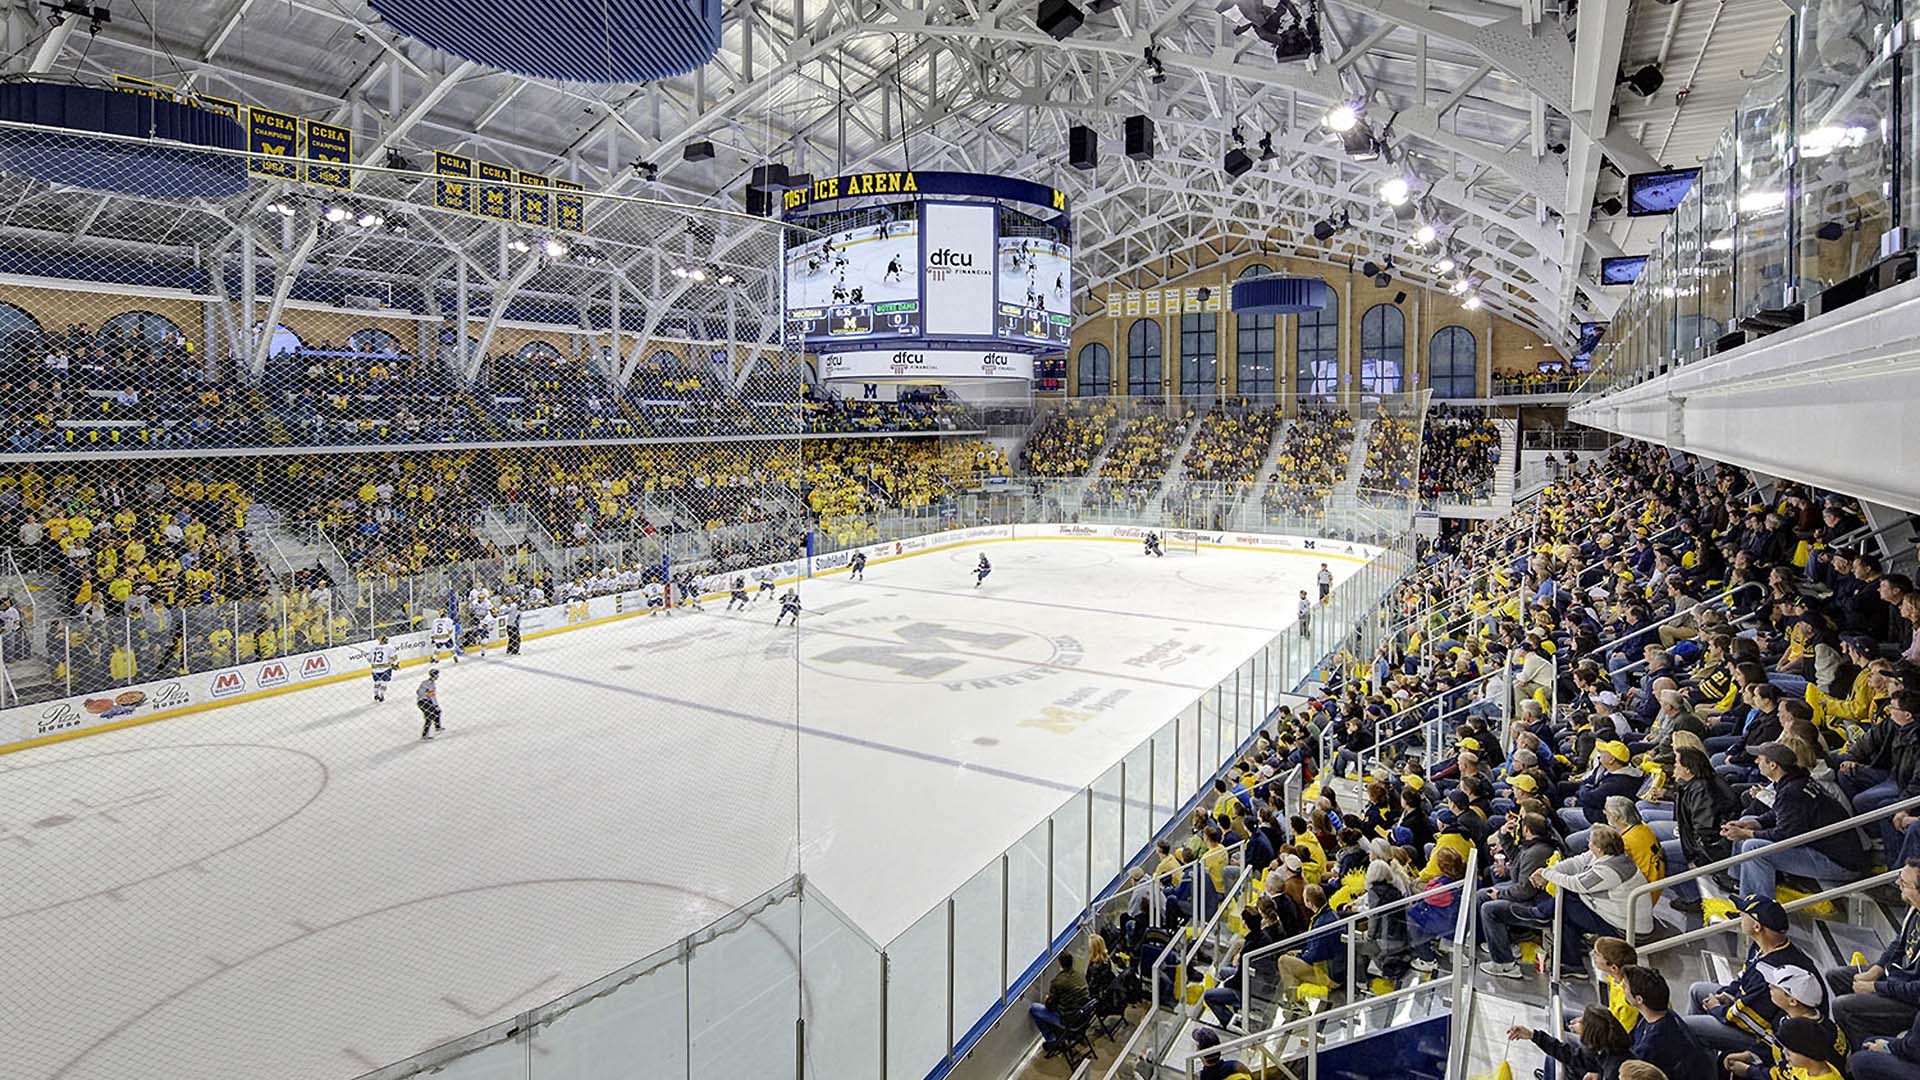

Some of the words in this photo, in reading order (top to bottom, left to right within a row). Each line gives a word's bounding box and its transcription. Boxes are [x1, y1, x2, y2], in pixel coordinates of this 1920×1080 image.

[253, 112, 295, 131] WCHA
[312, 126, 345, 142] CCHA
[440, 156, 467, 170] CCHA
[482, 166, 508, 180] CCHA
[522, 175, 545, 187] CCHA
[814, 178, 839, 201] ICE
[847, 171, 918, 196] ARENA
[1052, 188, 1065, 211] M
[930, 248, 973, 267] dfcu
[843, 317, 857, 329] M
[826, 354, 843, 367] dfcu
[892, 352, 924, 364] dfcu
[983, 352, 1008, 366] dfcu
[863, 383, 878, 399] M
[1304, 540, 1316, 550] M
[815, 552, 849, 571] StubHub!
[566, 602, 591, 623] M
[304, 656, 326, 671] M
[372, 651, 384, 664] 13
[262, 664, 284, 680] M
[1711, 670, 1729, 687] 21
[216, 673, 240, 689] M
[152, 697, 190, 710] House
[38, 720, 81, 734] House
